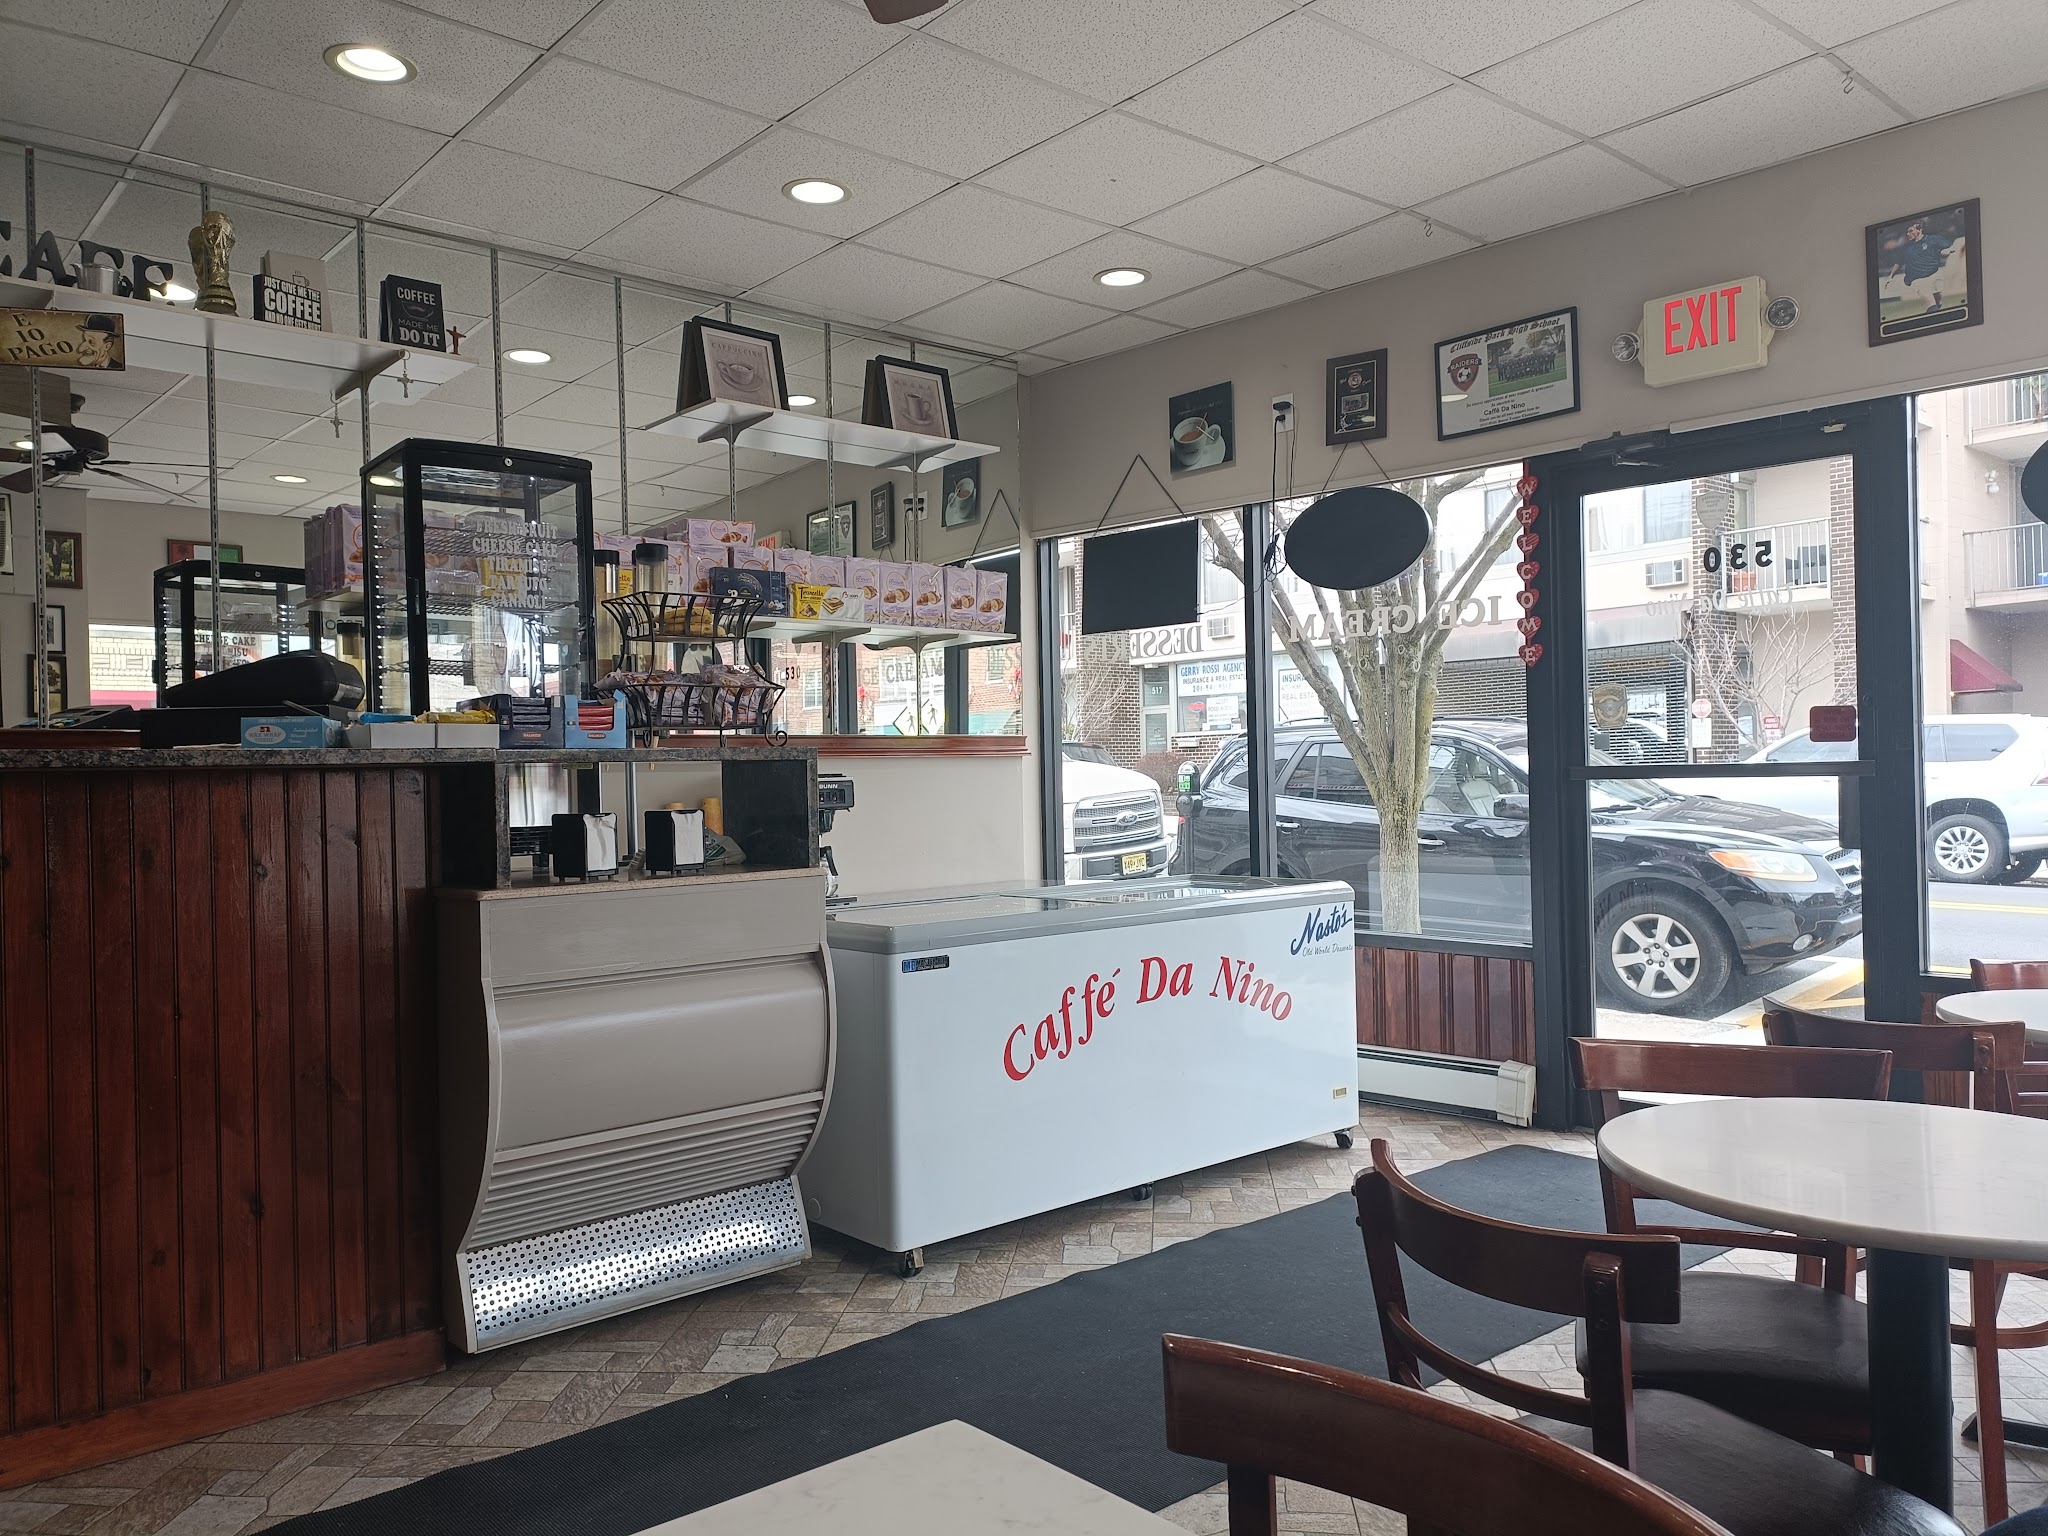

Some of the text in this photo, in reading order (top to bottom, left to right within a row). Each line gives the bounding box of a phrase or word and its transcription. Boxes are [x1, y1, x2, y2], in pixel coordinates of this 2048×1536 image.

[264, 276, 320, 302] JUST GIVE ME THE
[397, 286, 436, 306] COFFEE
[264, 287, 321, 324] COFFEE
[12, 313, 31, 327] E
[264, 309, 276, 323] AND
[398, 318, 439, 333] MADE ME
[1664, 285, 1742, 356] EXIT
[16, 328, 45, 343] IO
[399, 326, 440, 347] DO IT
[6, 340, 74, 361] PAGO
[1449, 358, 1480, 372] RAIDERS
[1511, 402, 1526, 410] Nino
[476, 520, 558, 540] FRESH FRUIT
[472, 537, 559, 558] CHEESE CAKE
[488, 555, 548, 575] TIRAMISU
[1519, 480, 1538, 663] WELCOME
[490, 591, 547, 610] CANNOLI
[194, 633, 257, 647] CHESE CAKE
[785, 666, 801, 681] 530
[886, 655, 944, 683] CREAM
[1181, 665, 1200, 677] GERRY
[1202, 663, 1220, 674] ROSSI
[1182, 676, 1210, 685] INSURANCE
[1694, 703, 1709, 713] STOP
[1291, 903, 1353, 955] Nasto's
[1303, 942, 1353, 957] Old World Desserts
[1003, 956, 1293, 1081] Caffé Da Nino
